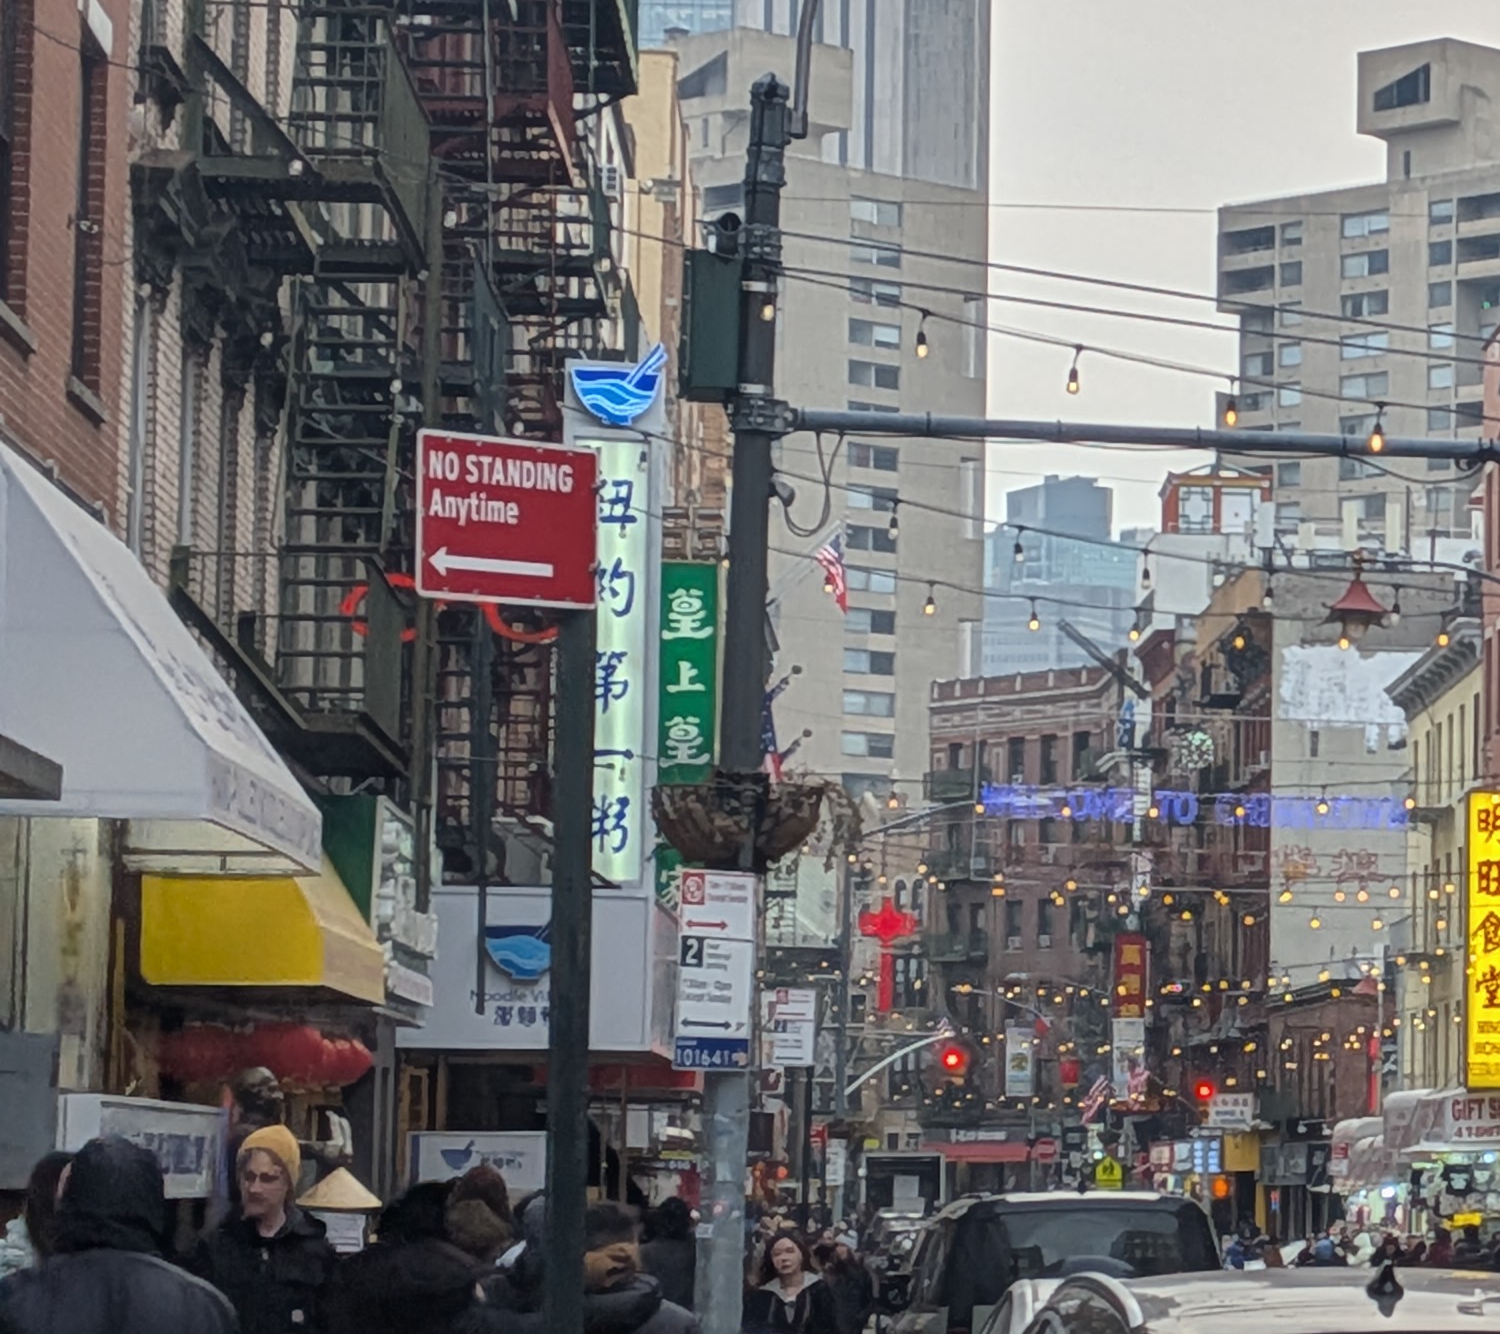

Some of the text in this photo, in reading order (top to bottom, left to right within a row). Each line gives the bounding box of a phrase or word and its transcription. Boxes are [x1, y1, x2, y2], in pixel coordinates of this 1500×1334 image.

[428, 450, 574, 493] NO STANDING
[428, 488, 519, 527] Anytime
[1154, 789, 1198, 825] TO
[685, 938, 700, 965] 2
[1452, 1098, 1485, 1122] GIFT
